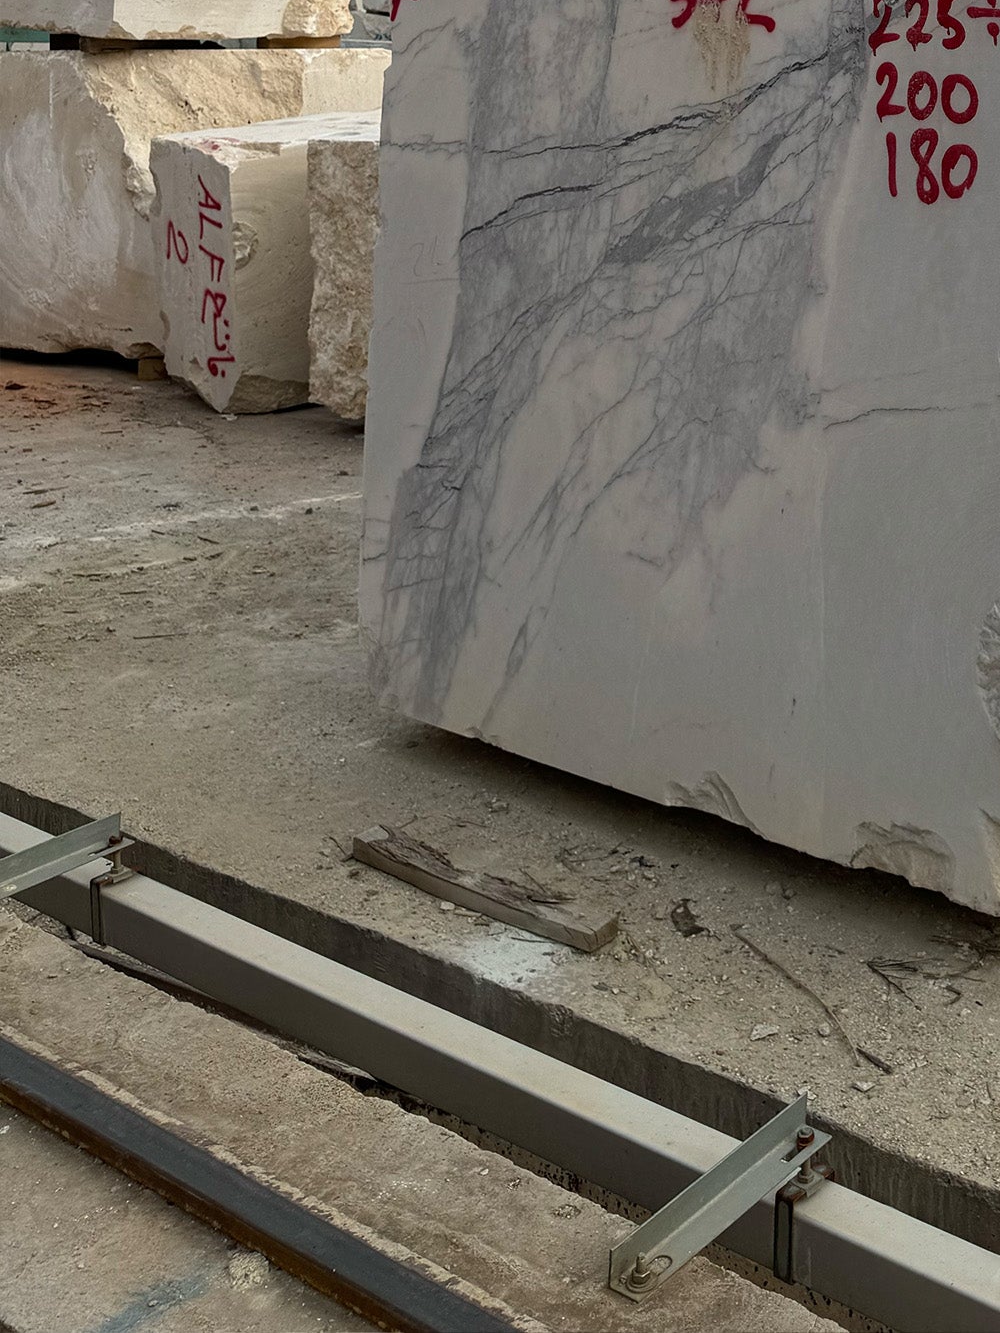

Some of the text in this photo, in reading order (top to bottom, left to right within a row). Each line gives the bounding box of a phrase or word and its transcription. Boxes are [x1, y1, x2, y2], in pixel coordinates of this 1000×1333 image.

[875, 61, 979, 124] 200
[885, 127, 979, 205] 180
[166, 219, 189, 265] 2
[197, 173, 225, 283] ALF
